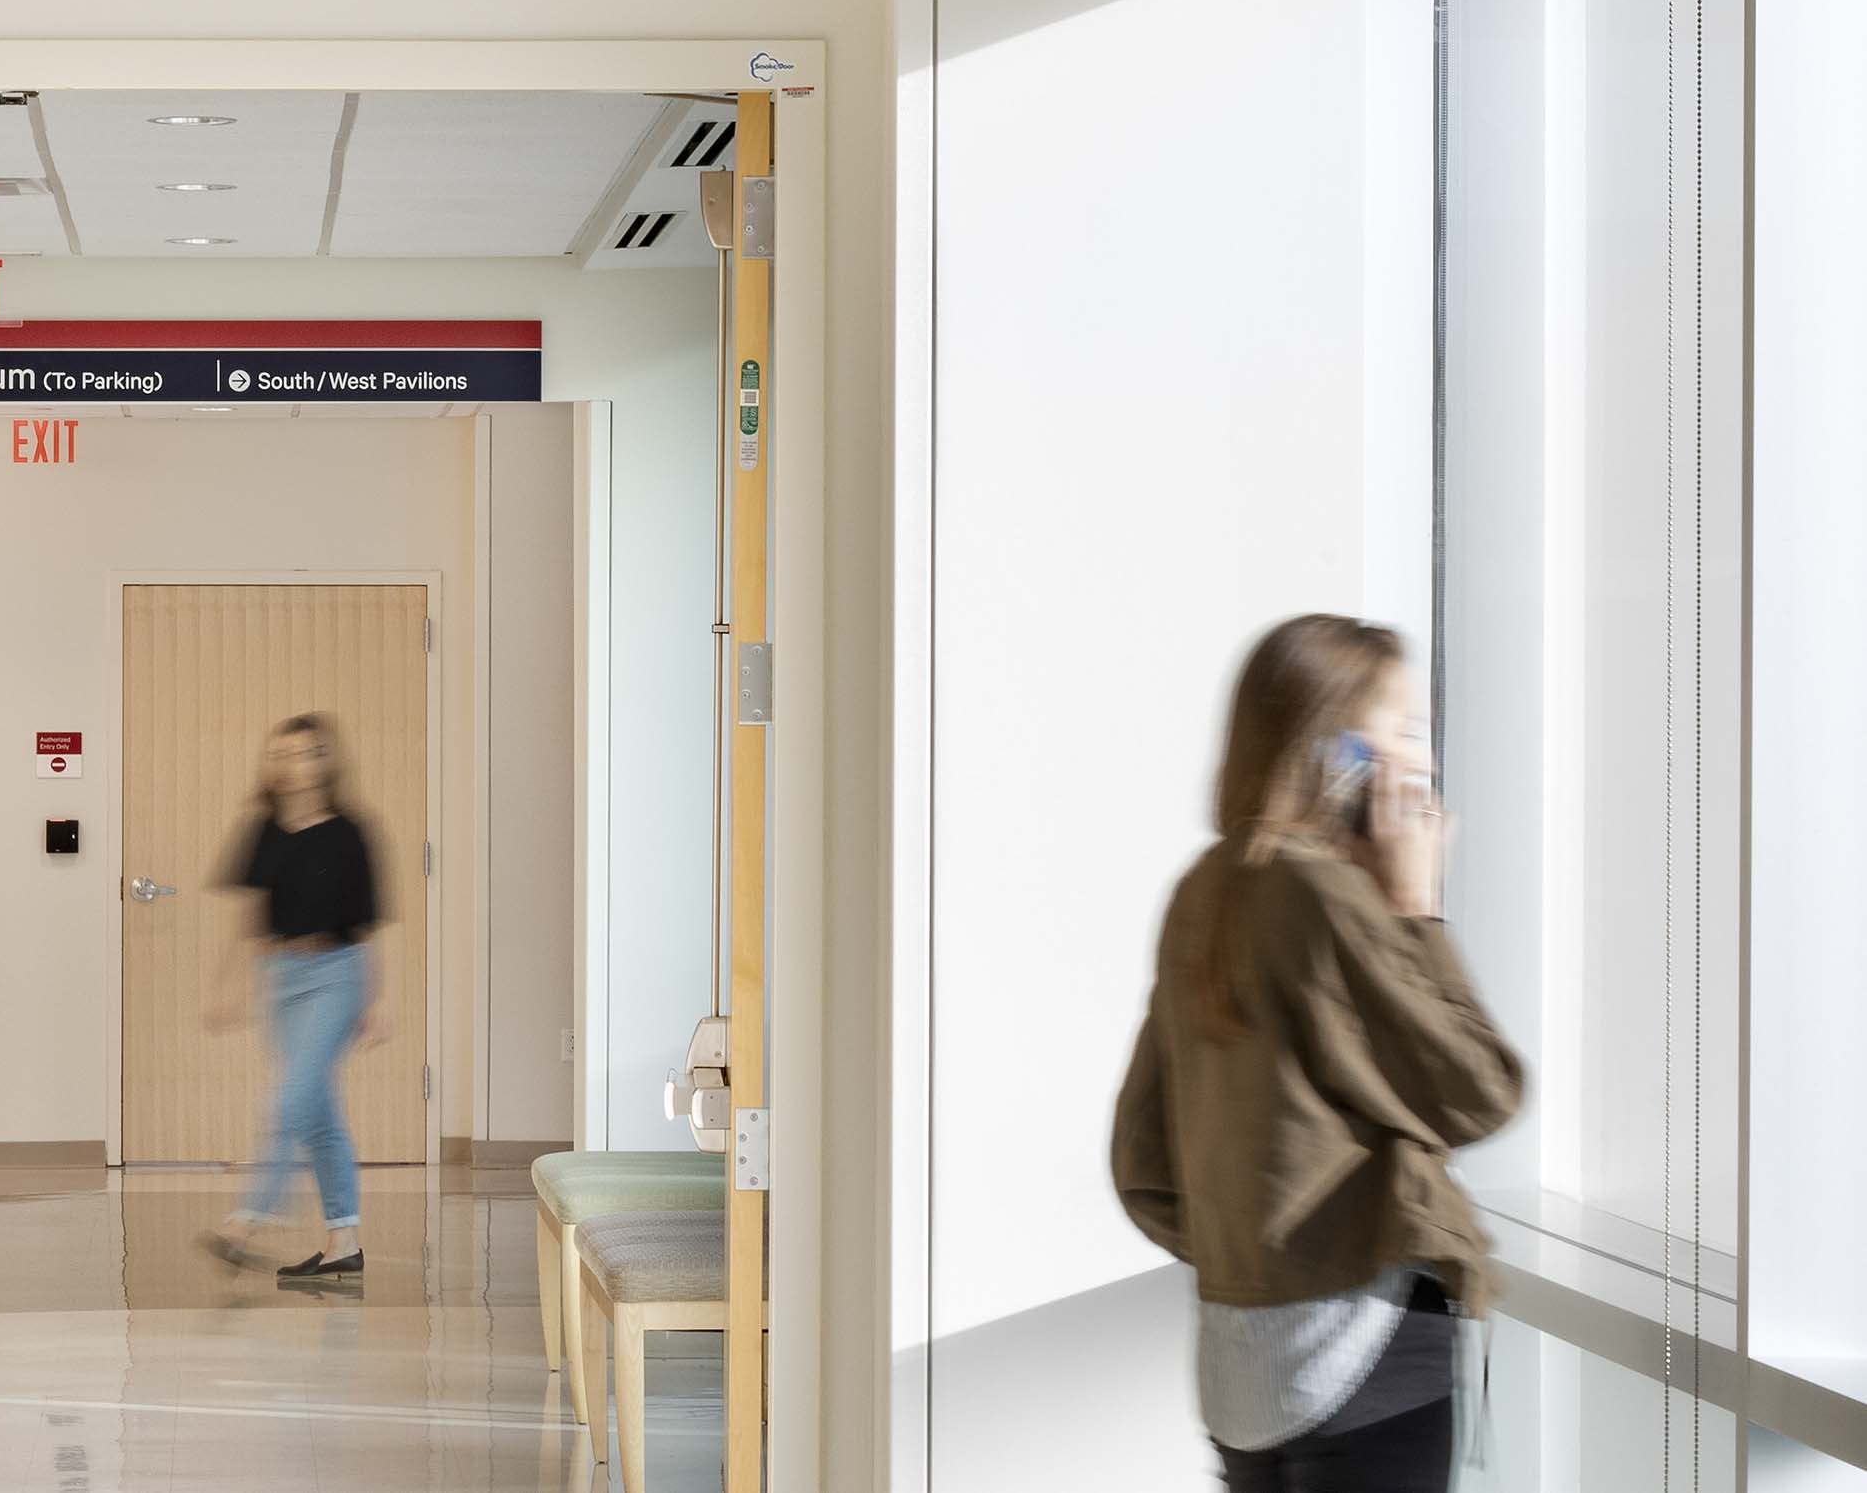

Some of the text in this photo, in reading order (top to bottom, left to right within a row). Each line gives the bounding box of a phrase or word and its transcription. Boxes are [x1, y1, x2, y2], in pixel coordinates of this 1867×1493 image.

[43, 371, 76, 392] (To
[82, 371, 163, 395] Parking)
[383, 371, 468, 390] Pavilions
[12, 419, 79, 464] EXIT
[39, 743, 70, 751] Entry Only
